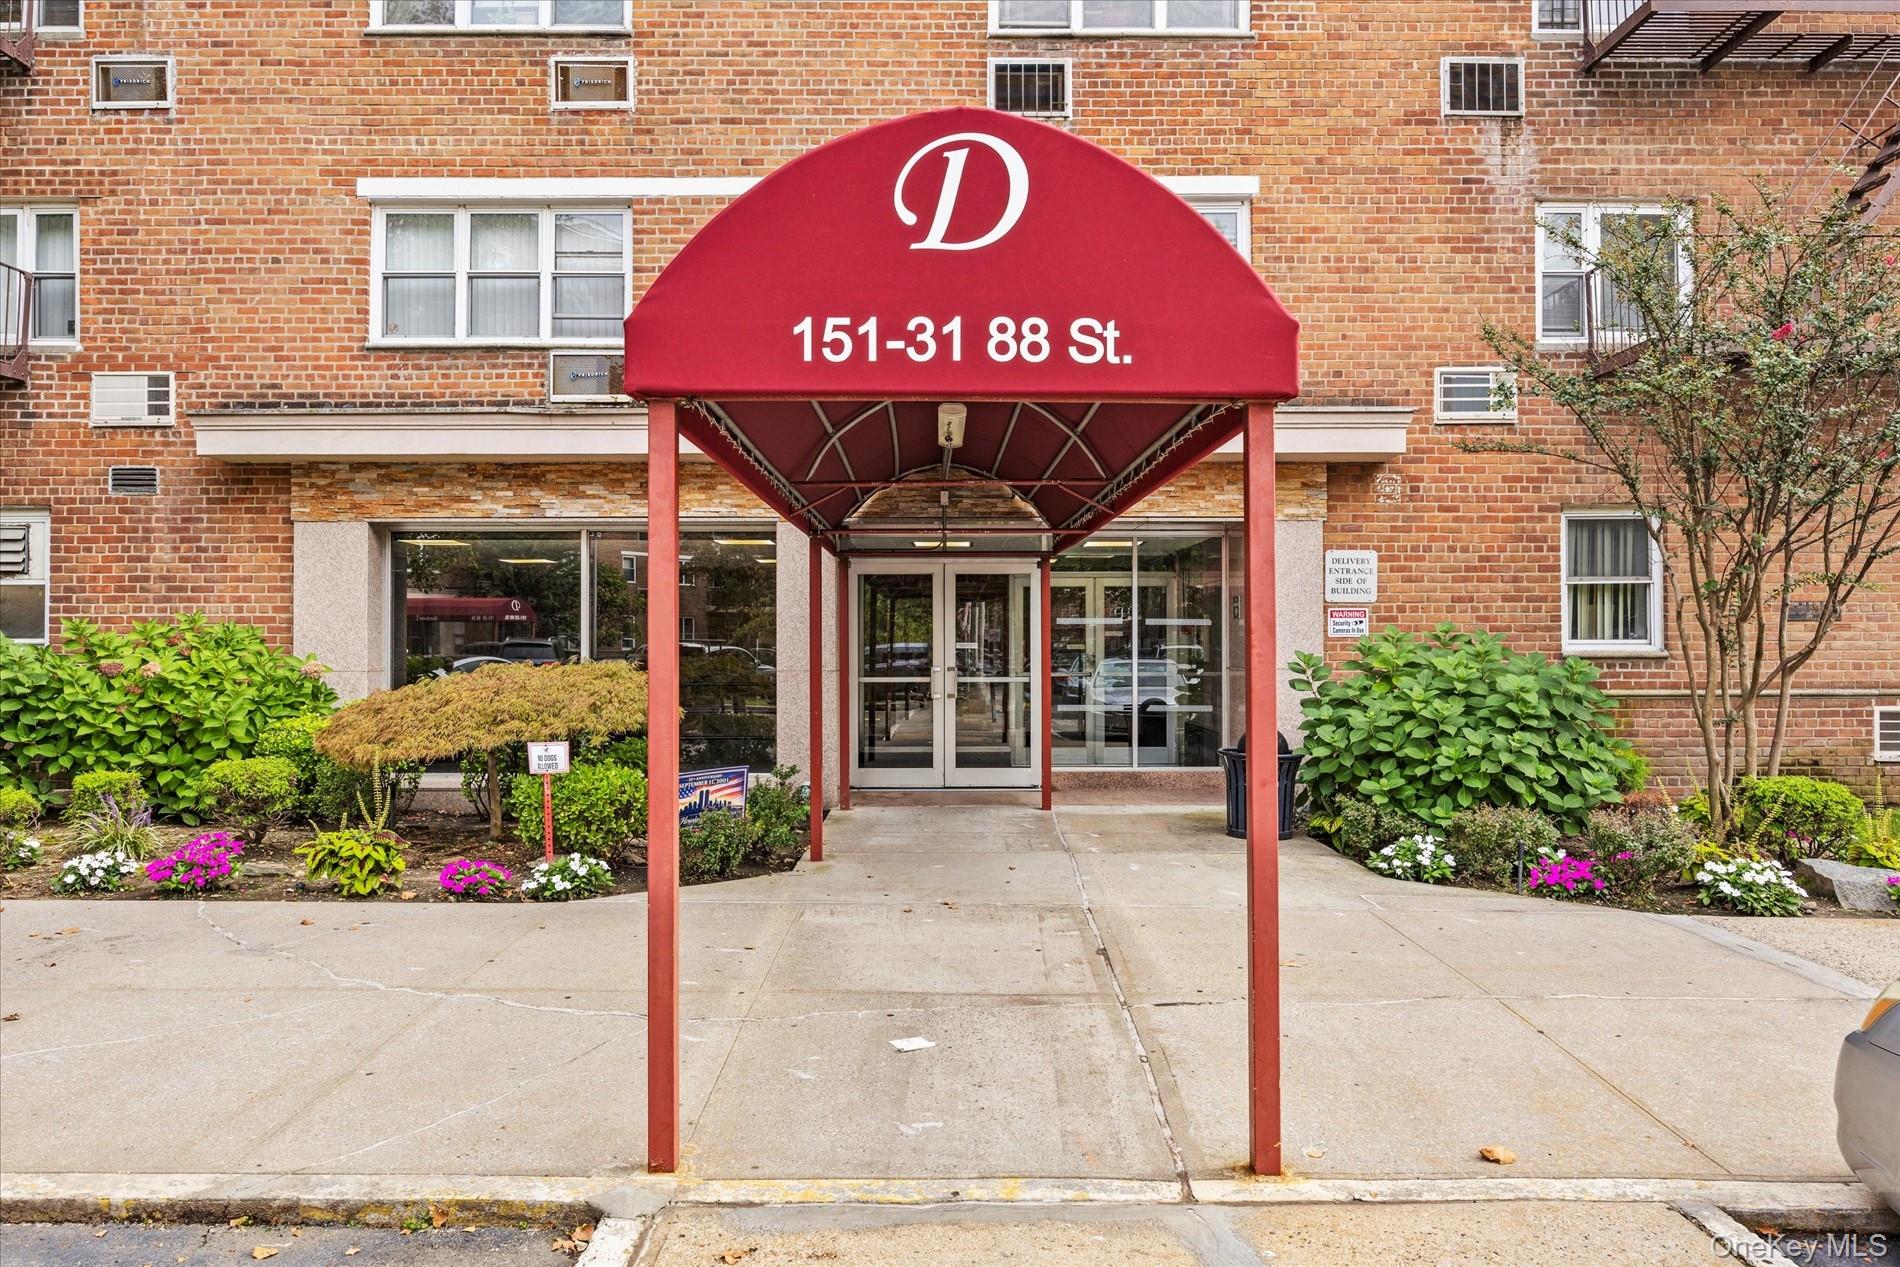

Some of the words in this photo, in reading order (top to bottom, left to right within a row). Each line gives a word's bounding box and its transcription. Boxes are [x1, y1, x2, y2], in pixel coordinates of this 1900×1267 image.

[893, 132, 1029, 251] D
[792, 315, 961, 362] 151-31
[986, 315, 1051, 363] 88
[1068, 317, 1133, 364] St.
[1331, 557, 1371, 565] DELIVERY
[1328, 567, 1374, 575] ENTRANCE
[1335, 577, 1353, 585] SIDE
[1356, 577, 1368, 585] OF
[1330, 587, 1372, 595] BUILDING
[537, 754, 543, 762] NO
[543, 754, 557, 762] DOGS
[537, 762, 559, 770] ALLOWED
